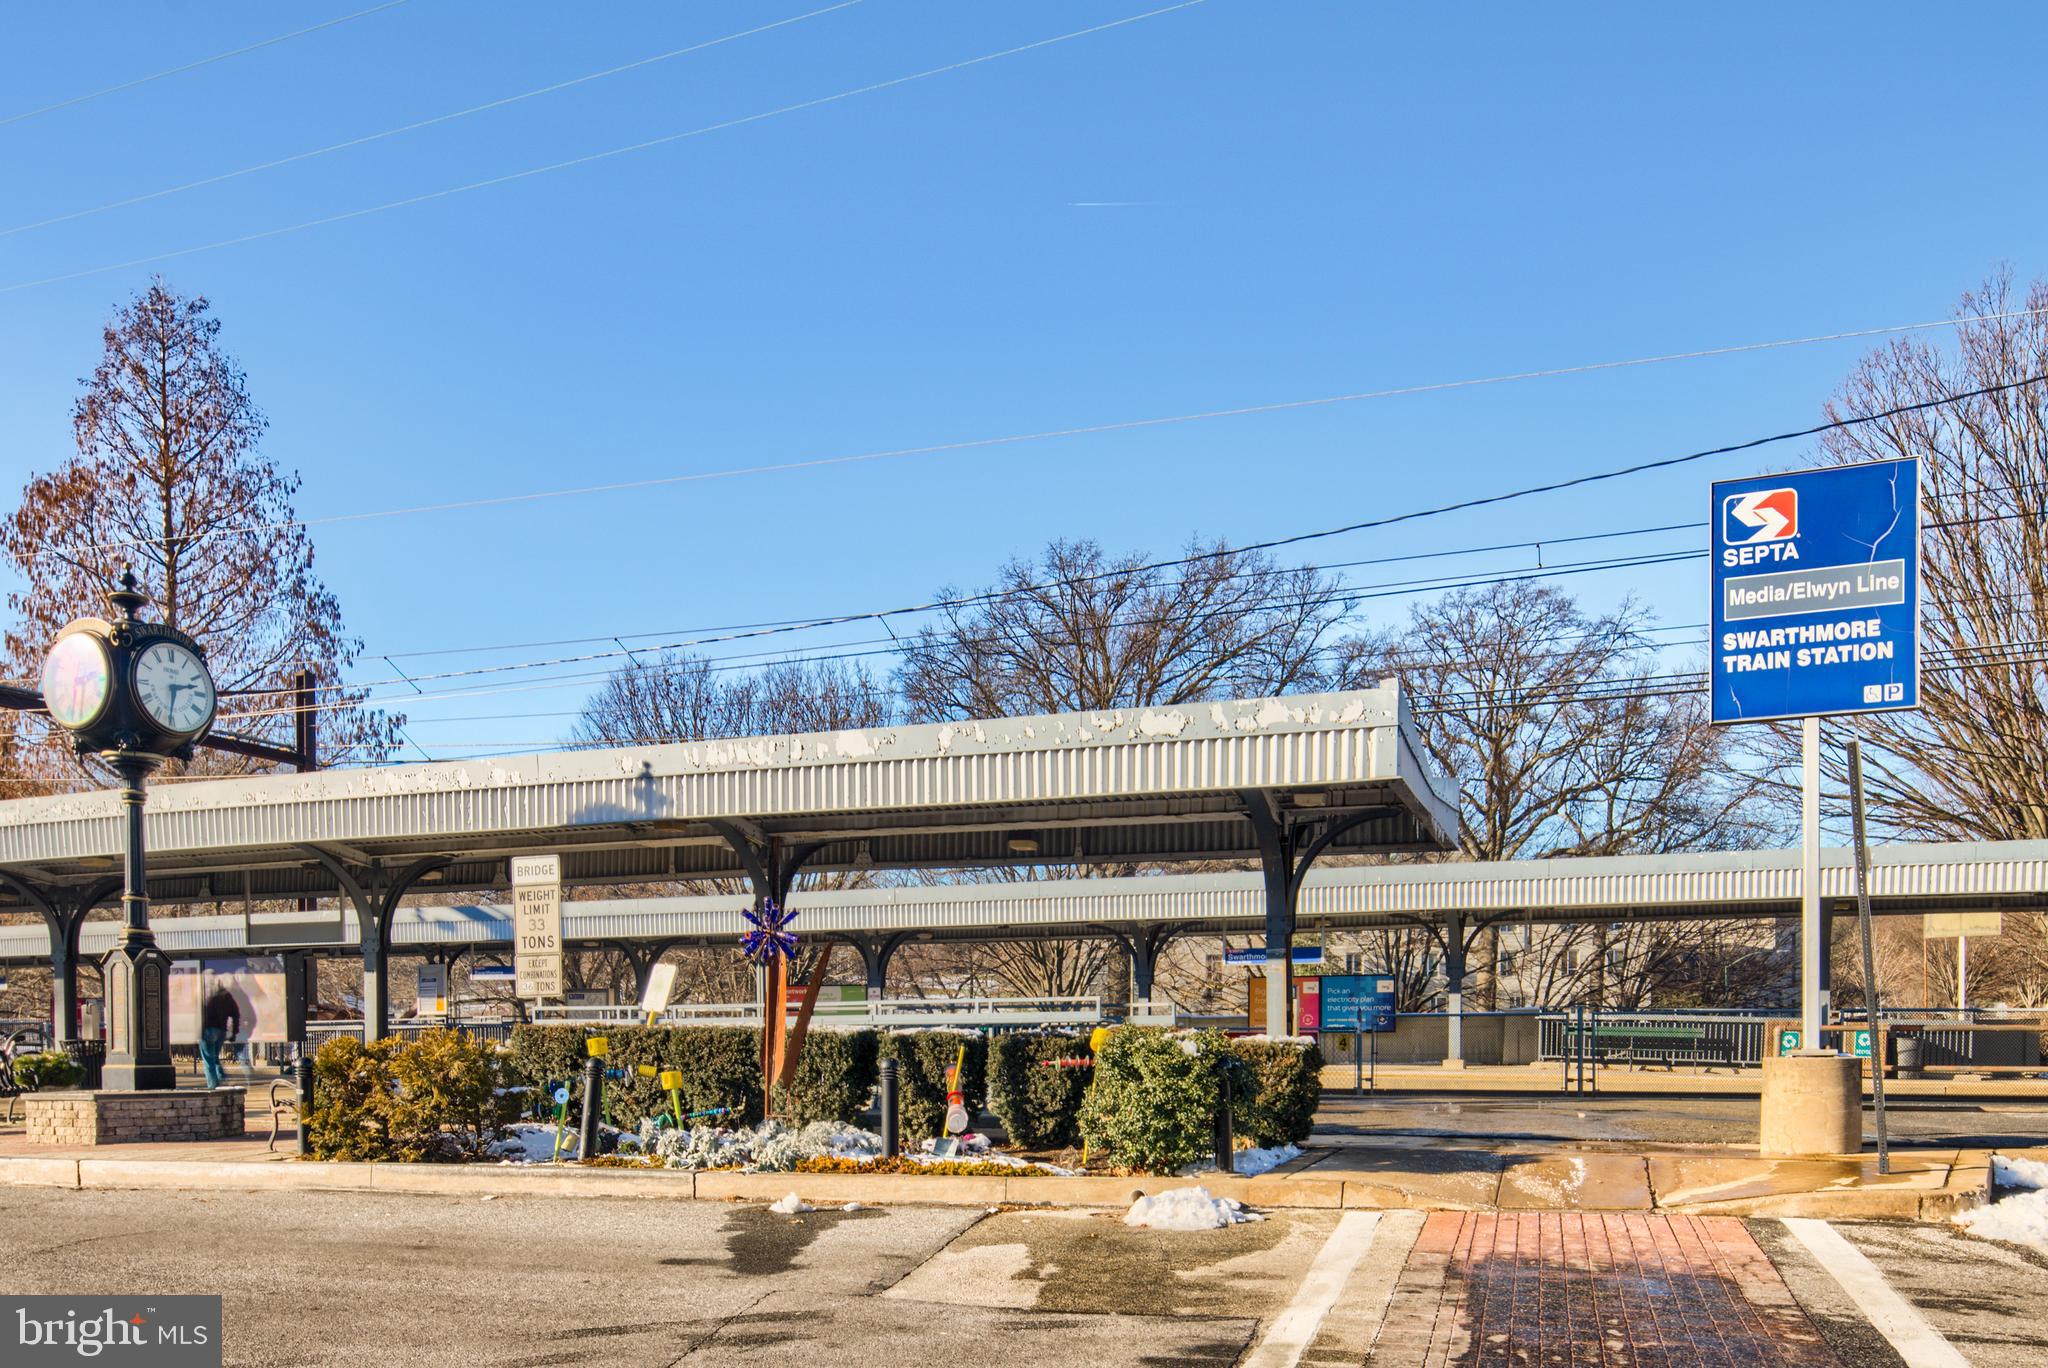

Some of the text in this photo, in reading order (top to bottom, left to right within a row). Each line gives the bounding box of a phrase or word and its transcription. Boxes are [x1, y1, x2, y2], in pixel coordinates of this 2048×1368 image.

[1723, 543, 1799, 568] SEPTA
[1729, 573, 1899, 606] Media/Elwyn Line
[1723, 618, 1881, 651] SWARTHMORE
[1723, 640, 1894, 673] TRAIN STATION
[517, 864, 555, 877] BRIDGE
[518, 889, 556, 902] WEIGHT
[523, 903, 550, 915] LIMIT
[528, 918, 545, 931] 33
[521, 935, 555, 949] TONS
[528, 958, 548, 969] EXCEPT
[1227, 953, 1267, 962] Swarthmo
[519, 969, 557, 980] COMBINATIONS
[536, 980, 556, 992] TONS
[1360, 996, 1375, 1004] plan
